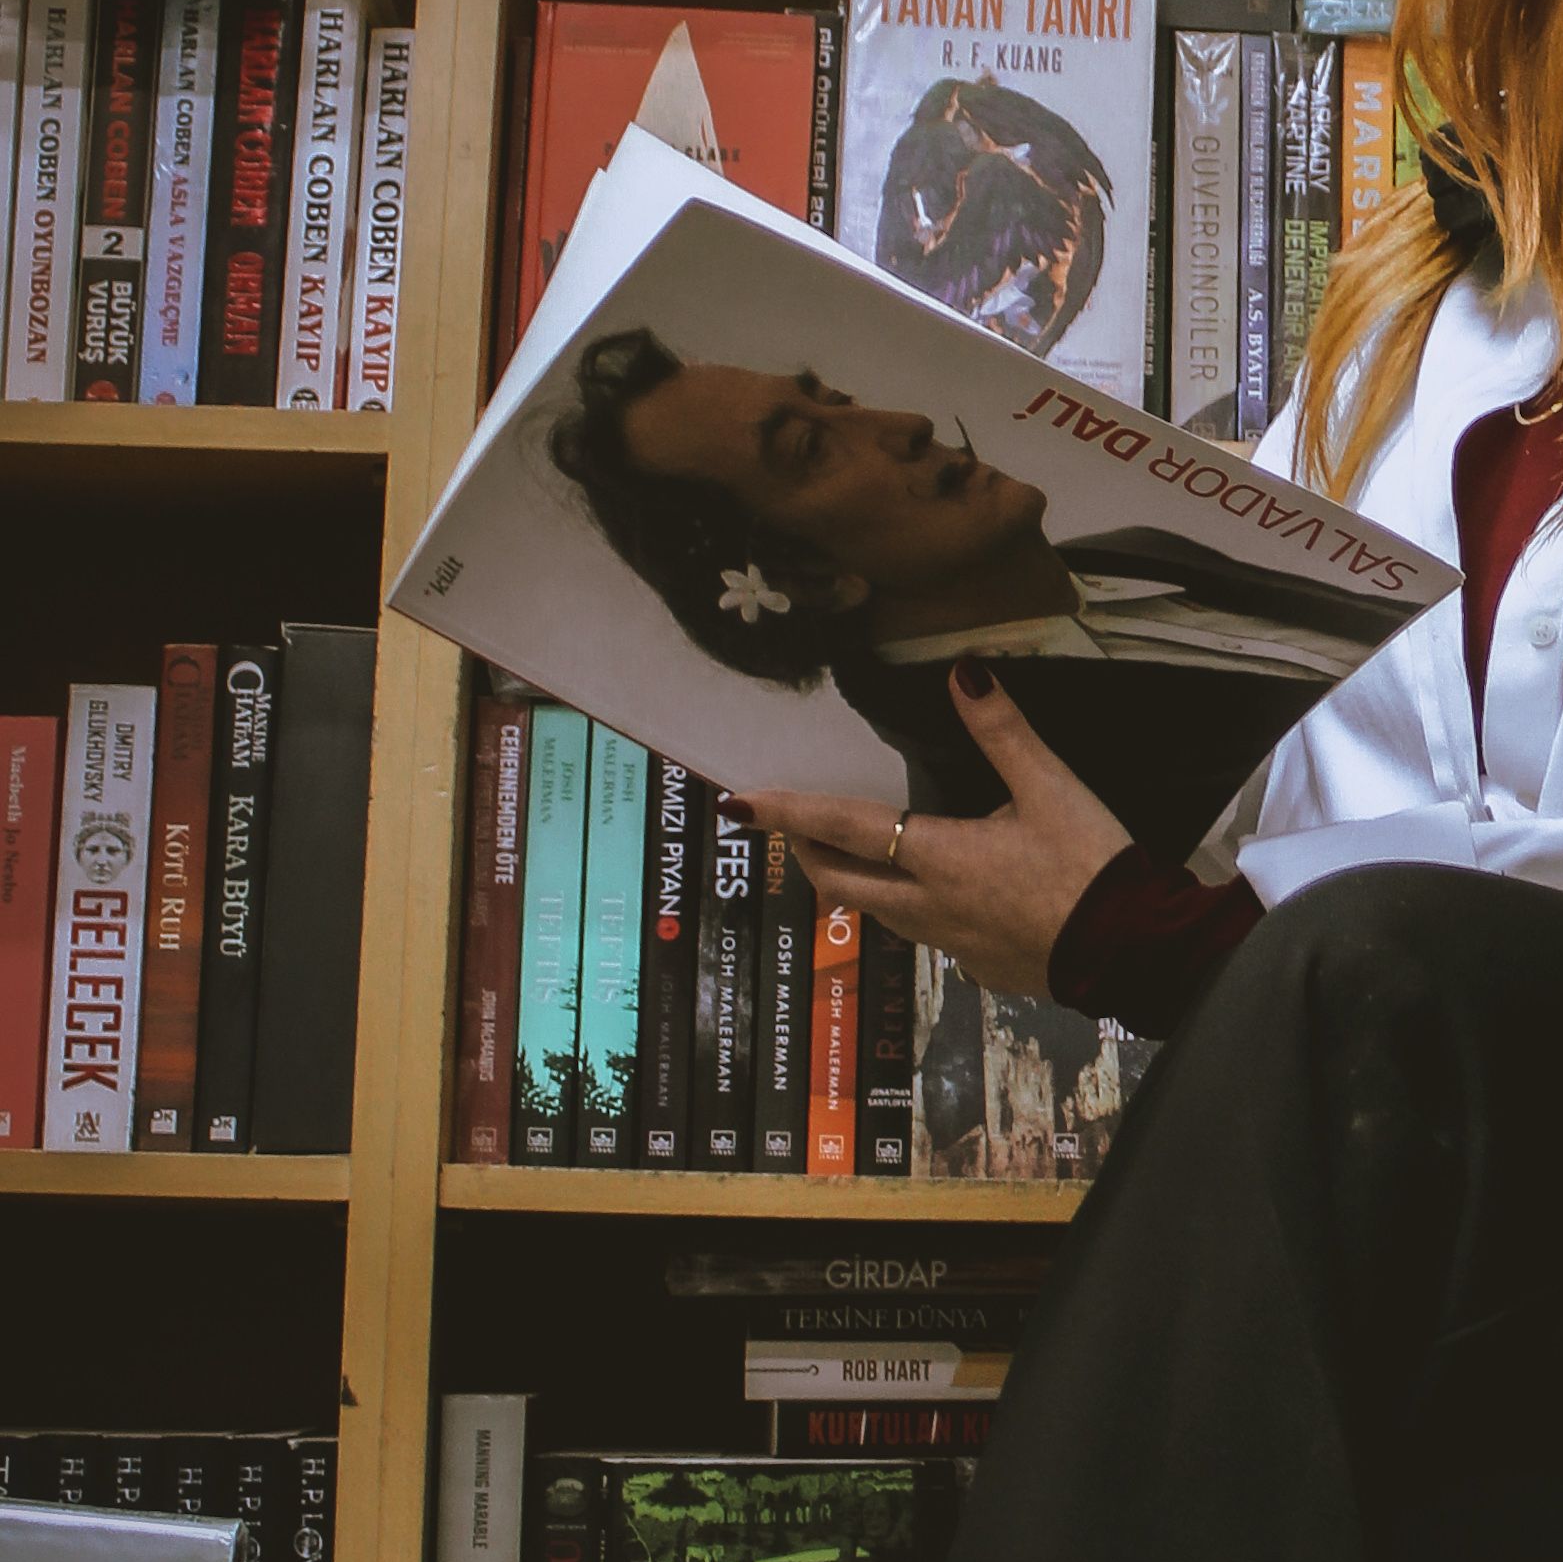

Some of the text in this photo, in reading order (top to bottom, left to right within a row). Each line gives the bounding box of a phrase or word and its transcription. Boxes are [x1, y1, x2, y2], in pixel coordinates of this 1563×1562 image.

[942, 39, 1063, 74] R. F. KUANG
[26, 6, 68, 367] HARLAN COBEN OYUNBOZAN
[102, 118, 132, 220] COBEN
[158, 6, 200, 348] HARLAN COBEN ASLA VAZGEÇME
[293, 7, 345, 374] HARLAN COBEN KAYIP
[360, 39, 409, 394] HARLAN COBEN KAYIP
[102, 231, 124, 257] 2
[223, 127, 272, 356] COBEN ORMAN
[1189, 133, 1221, 383] GÜVERCİNCİLER
[78, 279, 108, 365] VURUŞ
[110, 280, 134, 367] BÜYÜK
[1245, 332, 1265, 402] BYATT
[1144, 433, 1421, 595] SALVADOR
[83, 699, 110, 805] GLUKHOVSKY
[113, 722, 136, 784] DMITRY
[226, 659, 266, 771] CHATTAM
[250, 692, 274, 764] MAXIME
[5, 745, 27, 825] Macbeth
[494, 724, 521, 885] CEHENNEMDEN ÖTE
[158, 821, 191, 953] KÖTÜ RUH
[217, 793, 255, 959] KARA BÜYÜ
[60, 888, 130, 1094] GELECEK
[716, 927, 737, 1093] JOSH MALERMAN
[773, 925, 793, 1091] JOSH MALERMAN
[827, 976, 845, 1112] JOSH MALERMAN
[782, 1304, 987, 1329] TERSİNE DÜNYA
[825, 1253, 947, 1289] GİRDAP
[842, 1360, 931, 1382] ROB HART
[116, 1456, 142, 1505] H.P.
[300, 1457, 326, 1506] H.P.
[808, 1410, 954, 1445] KURTULAN
[471, 1428, 492, 1550] MANNING MARABLE
